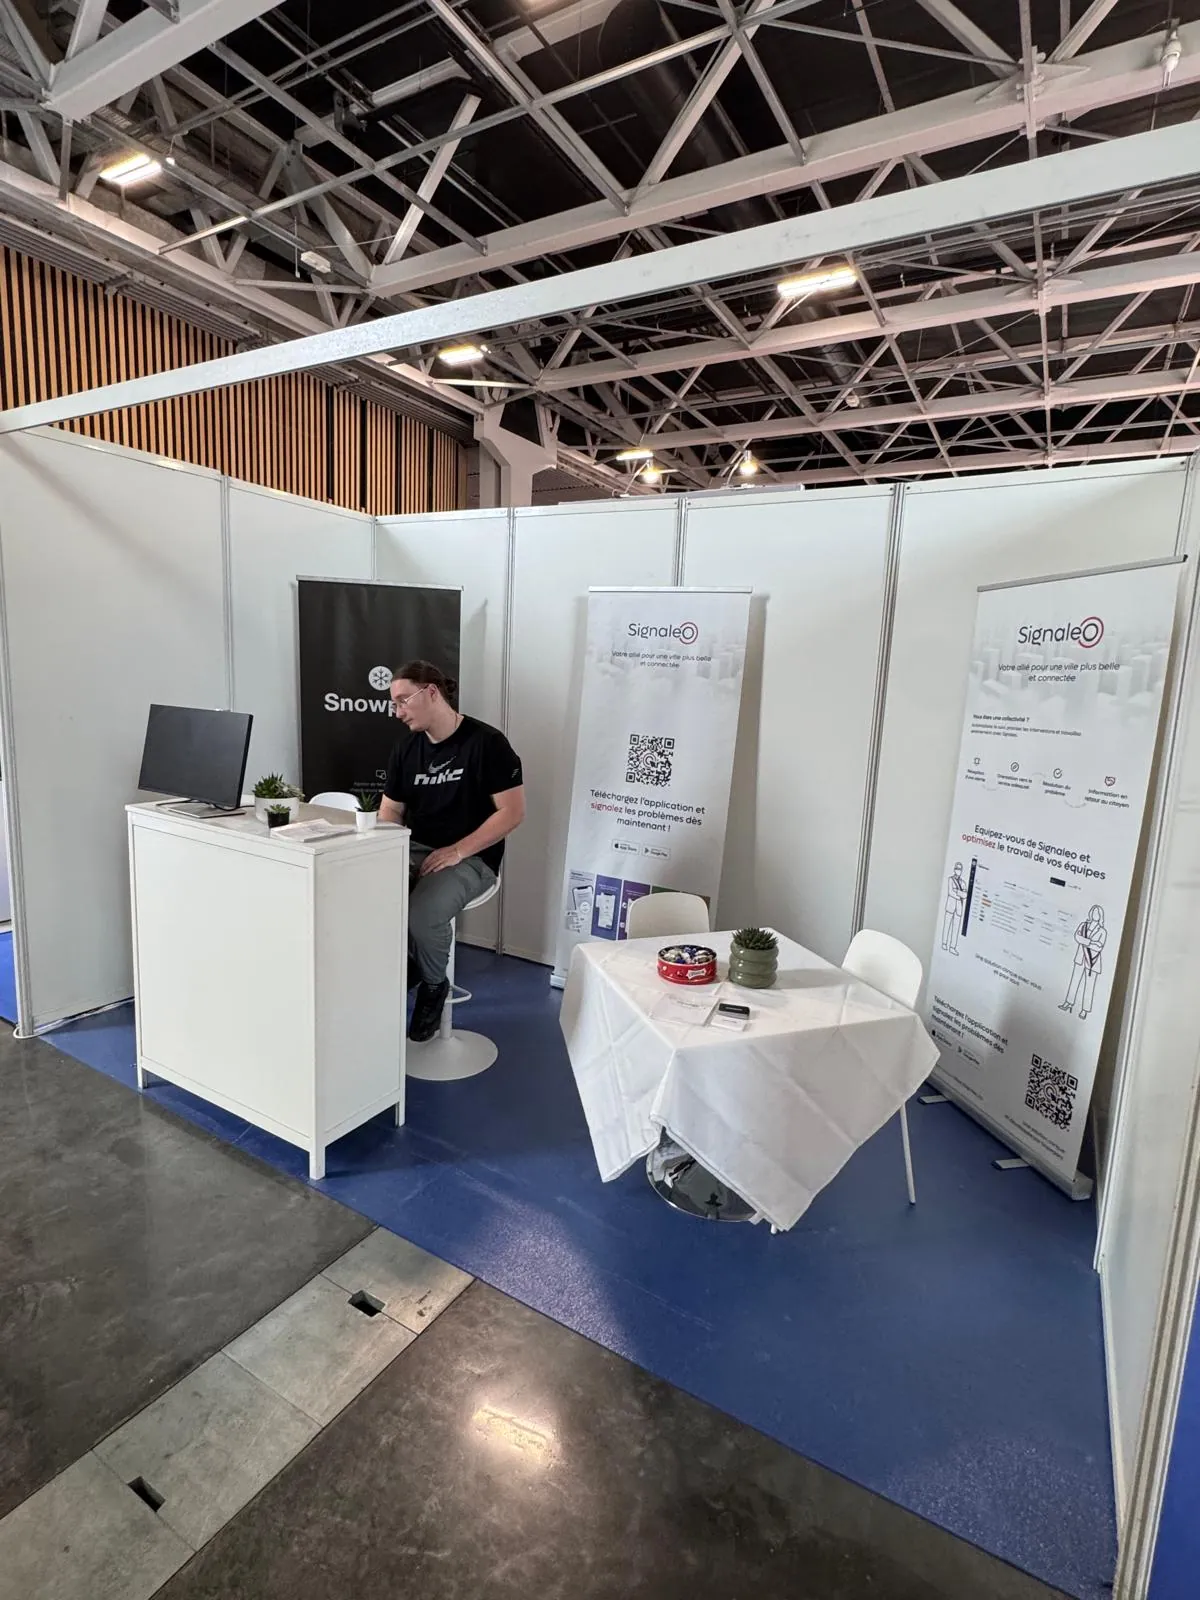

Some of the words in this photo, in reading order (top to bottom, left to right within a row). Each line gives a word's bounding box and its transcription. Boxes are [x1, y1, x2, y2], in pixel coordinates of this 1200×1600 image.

[612, 650, 627, 658] Votre
[1031, 664, 1048, 672] pour
[1064, 662, 1078, 671] ville
[1080, 662, 1097, 671] plus
[1098, 662, 1120, 670] belle
[1038, 674, 1076, 682] connectée
[590, 789, 638, 804] Téléchargez
[640, 797, 694, 812] l'application
[695, 806, 706, 814] et
[590, 802, 623, 813] signalez
[638, 810, 684, 823] problèmes
[686, 816, 702, 826] dès
[617, 817, 666, 832] maintenant
[962, 833, 996, 849] optimisez
[997, 842, 1005, 851] le
[1006, 844, 1032, 859] travail
[1034, 852, 1045, 862] de
[1046, 858, 1062, 868] vos
[1064, 860, 1106, 880] équipes
[1026, 838, 1036, 848] de
[1038, 842, 1078, 860] Signaleo
[1080, 854, 1091, 864] et
[1002, 1038, 1008, 1046] et
